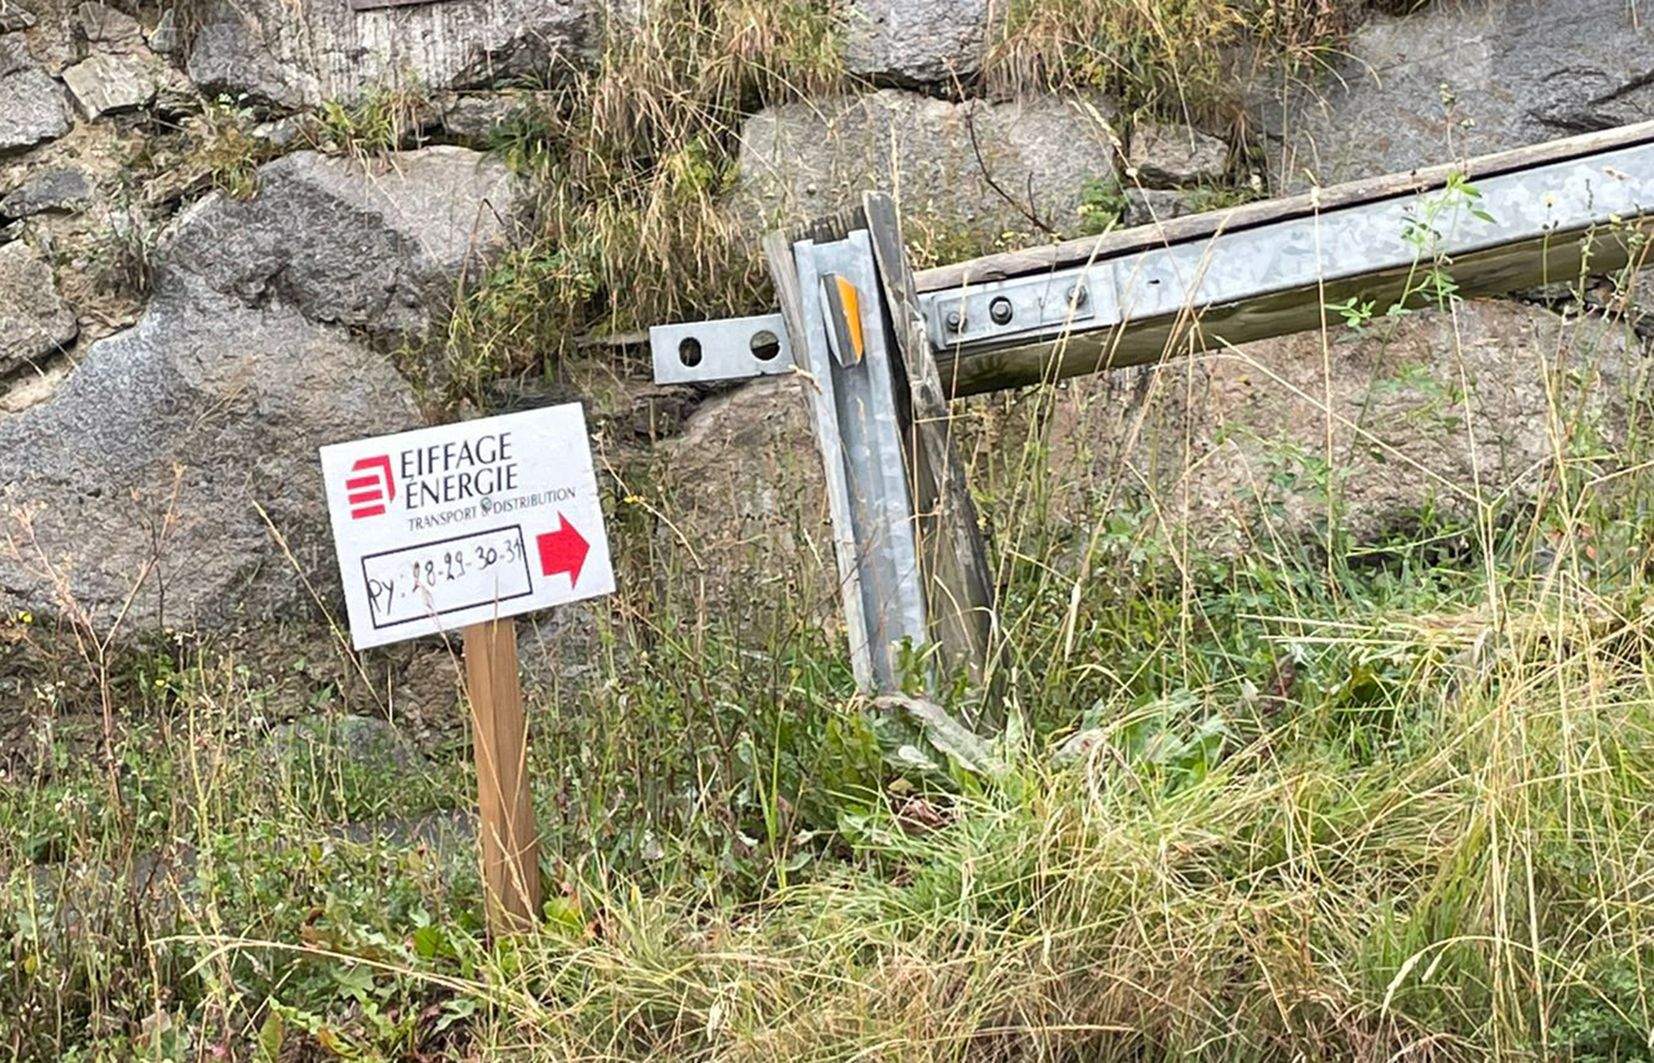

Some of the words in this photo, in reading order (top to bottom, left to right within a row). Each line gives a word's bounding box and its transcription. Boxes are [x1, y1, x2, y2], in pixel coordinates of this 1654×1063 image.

[401, 432, 512, 479] EIFFAGE
[408, 506, 478, 532] TRANSPORT
[493, 486, 577, 515] DISTRIBUTION
